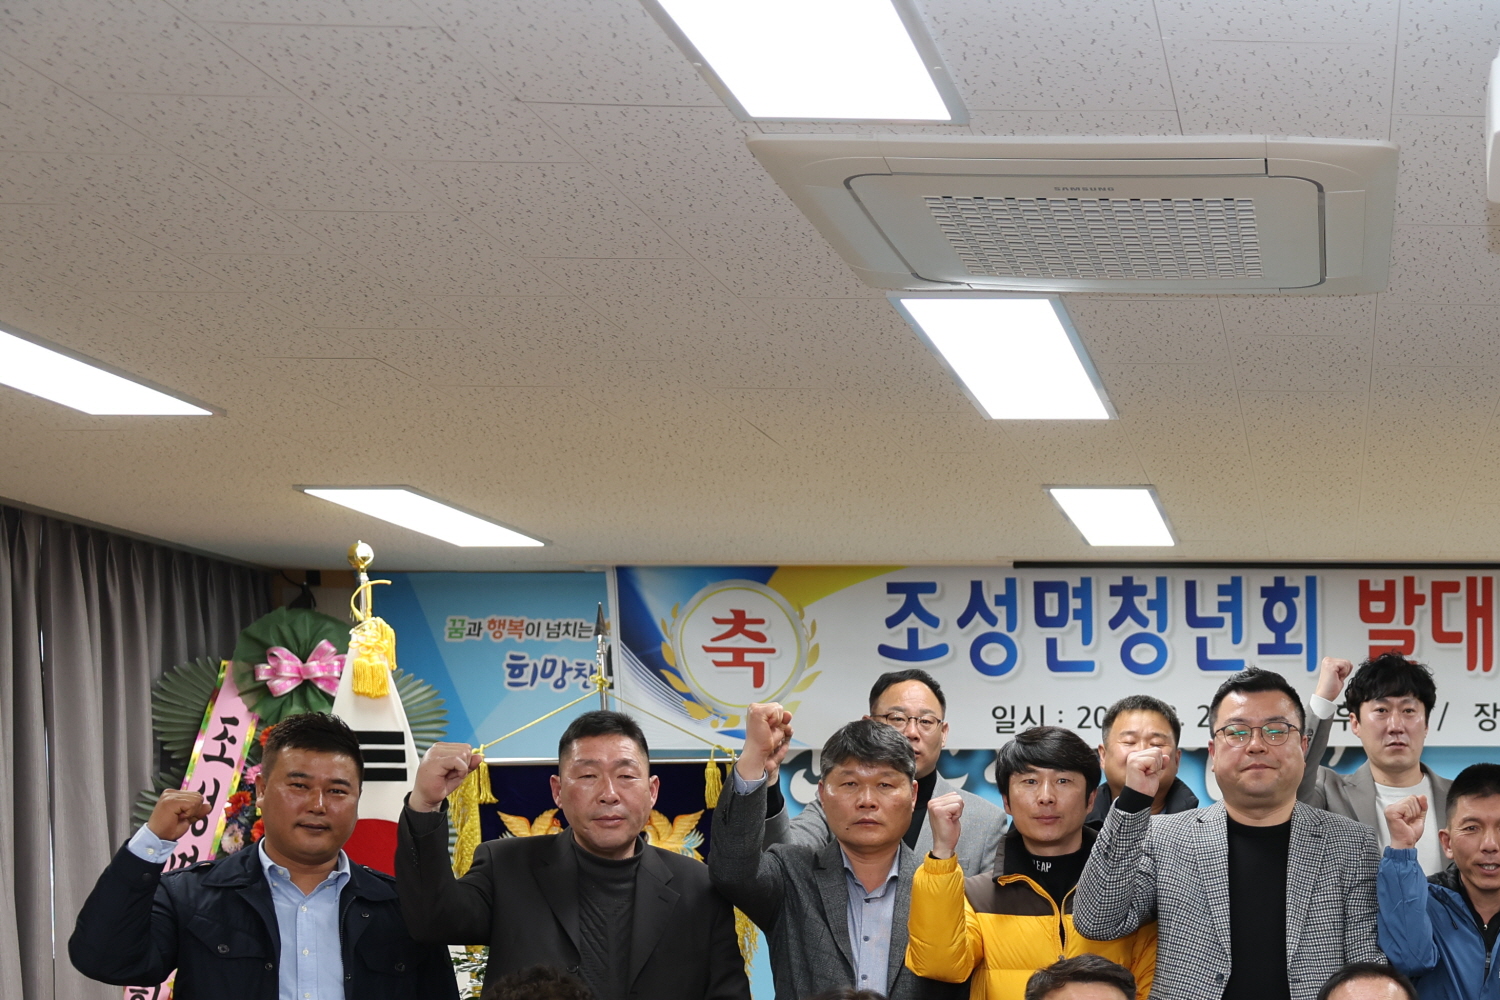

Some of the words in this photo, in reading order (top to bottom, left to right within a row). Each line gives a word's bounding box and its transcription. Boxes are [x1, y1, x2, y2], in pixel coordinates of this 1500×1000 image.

[447, 618, 482, 640] 꿈과
[487, 618, 541, 640] 행복이
[546, 620, 593, 639] 넘치는
[877, 575, 1319, 677] 조성면청년회
[702, 608, 776, 689] 축
[991, 704, 1045, 734] 일시
[1032, 859, 1052, 873] EAP
